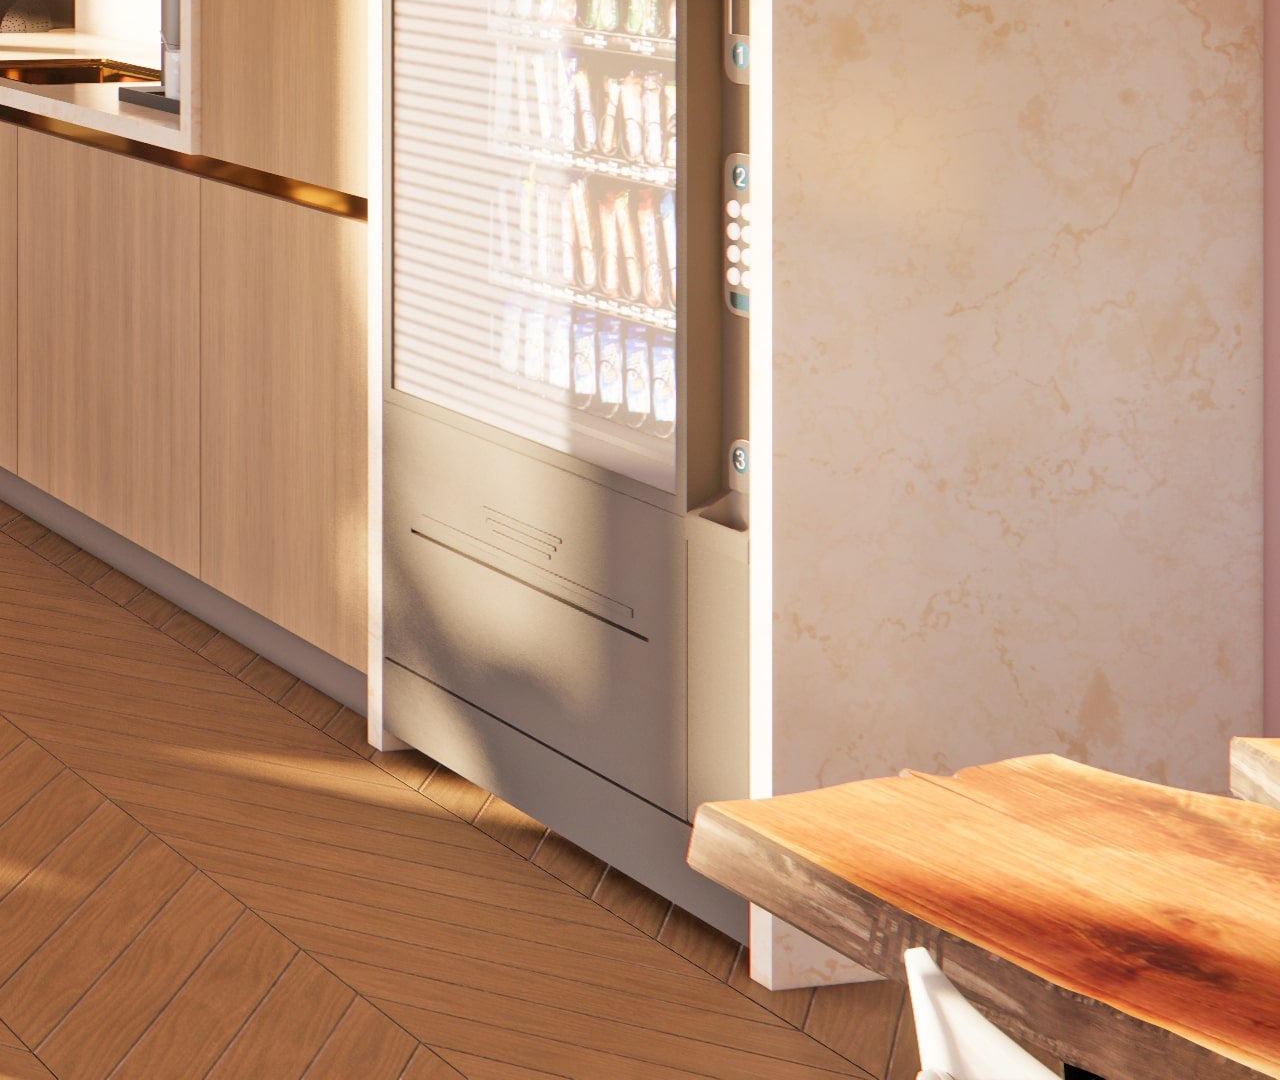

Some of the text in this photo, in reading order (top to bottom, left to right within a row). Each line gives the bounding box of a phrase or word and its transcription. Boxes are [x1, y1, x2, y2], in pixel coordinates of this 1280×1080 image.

[736, 46, 744, 65] 1
[735, 167, 746, 187] 2
[735, 449, 746, 470] 3
